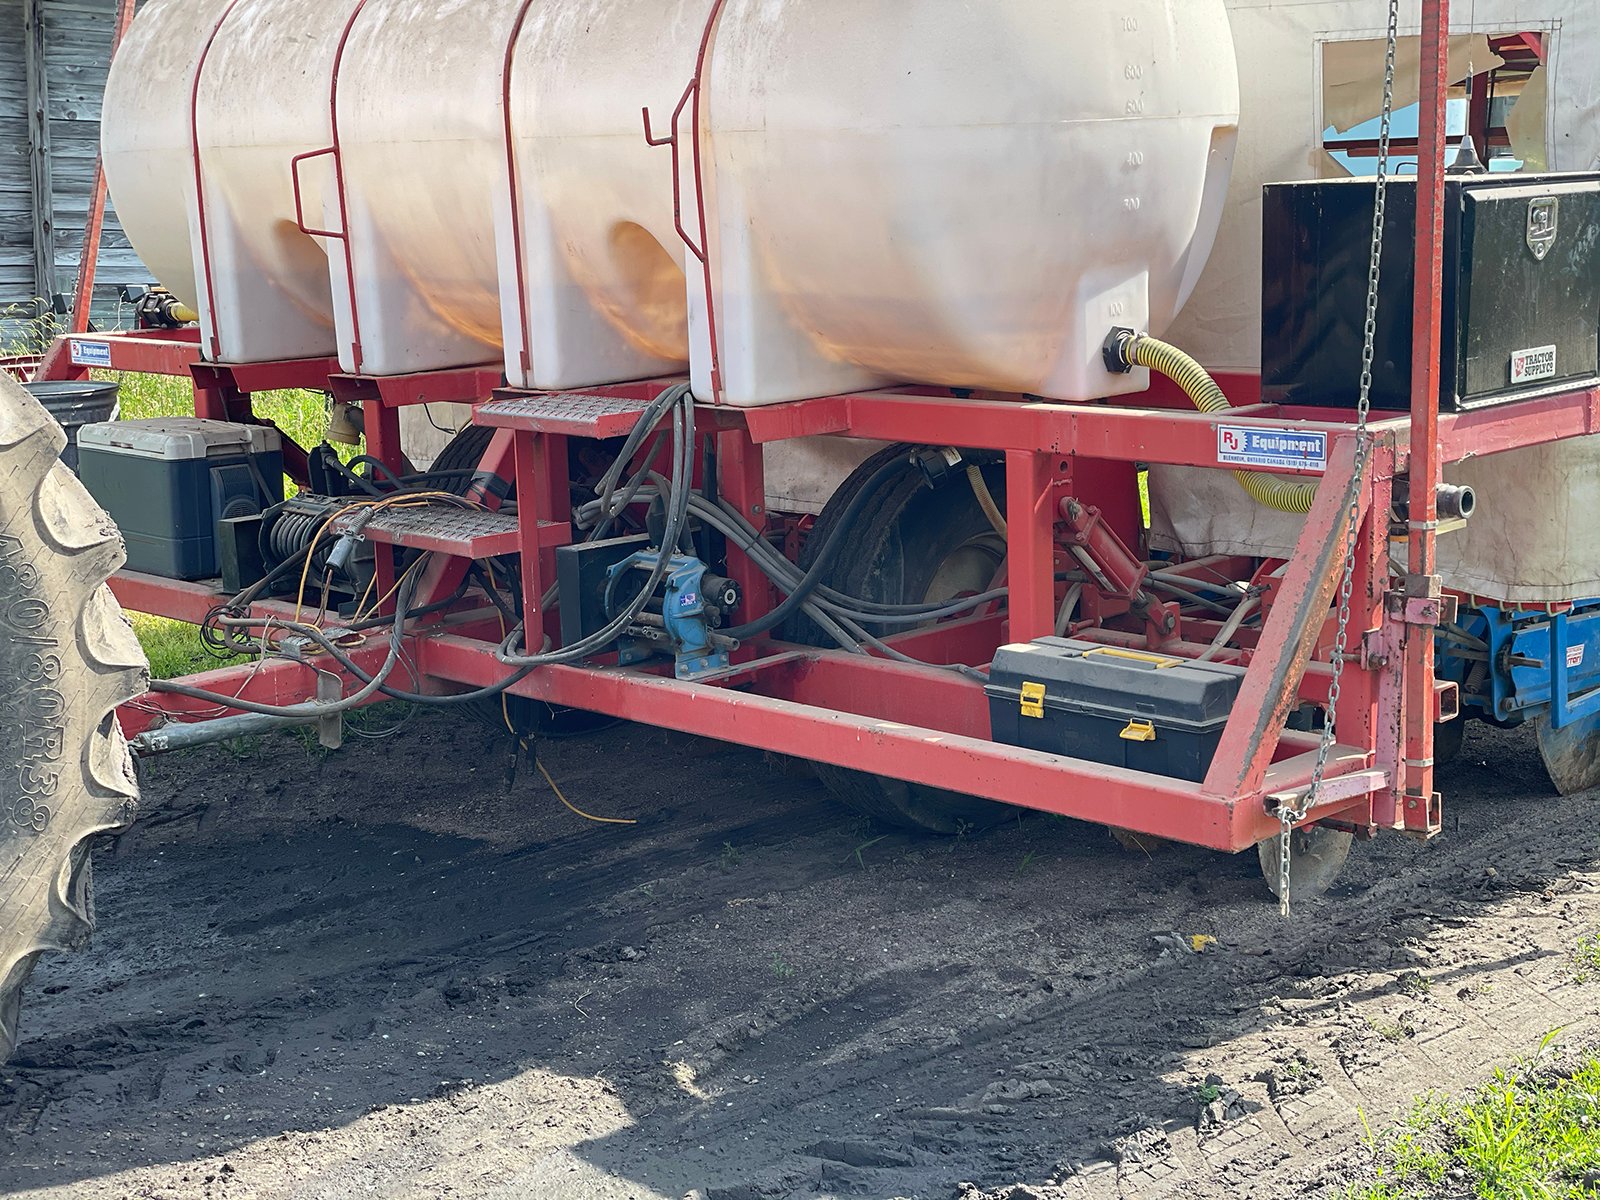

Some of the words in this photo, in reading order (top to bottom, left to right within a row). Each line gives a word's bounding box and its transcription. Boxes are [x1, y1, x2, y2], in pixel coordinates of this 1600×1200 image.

[1120, 17, 1138, 32] 700
[1124, 64, 1143, 80] 600
[1109, 302, 1123, 317] 100
[1525, 351, 1554, 365] TRACTOR
[1524, 363, 1546, 377] SUPPLY
[1223, 431, 1238, 450] RJ
[1252, 435, 1321, 452] Equipment
